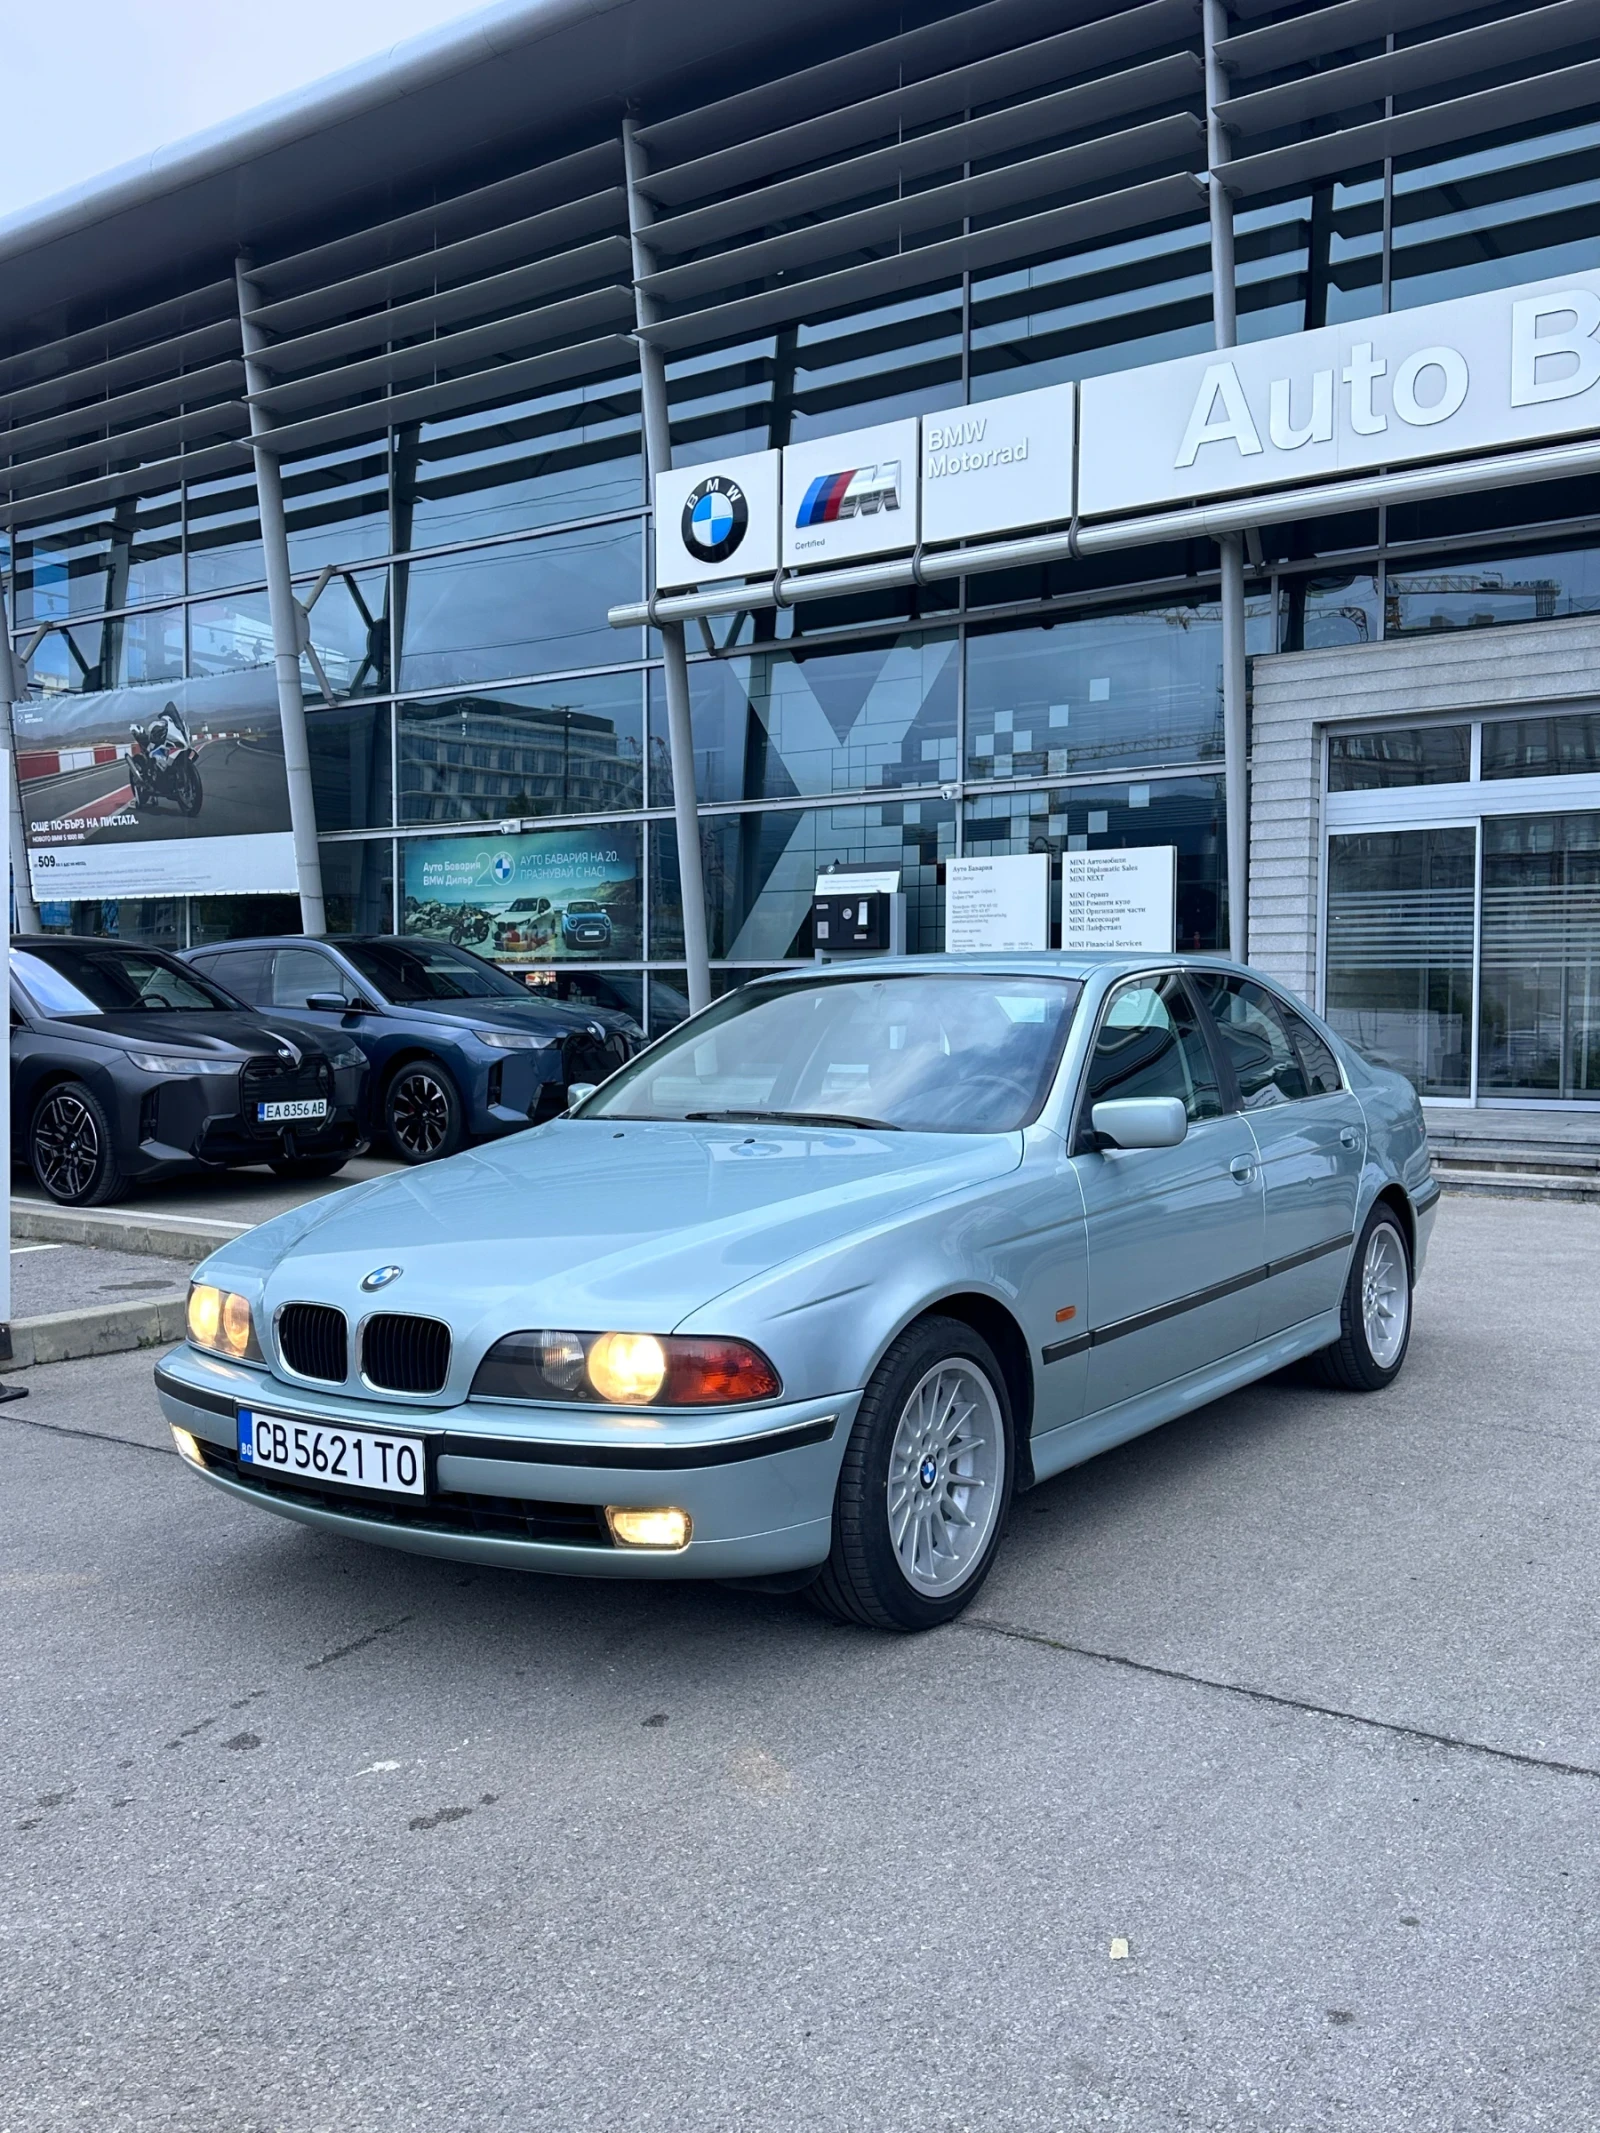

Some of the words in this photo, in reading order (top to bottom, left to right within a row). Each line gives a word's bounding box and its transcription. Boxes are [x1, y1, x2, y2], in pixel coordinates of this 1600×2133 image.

[1174, 342, 1469, 469] Auto
[929, 418, 987, 452] BMW
[928, 436, 1028, 479] Motorrad
[686, 478, 742, 510] BMW
[795, 538, 825, 550] Certified
[31, 820, 50, 832] ОЩЕ
[51, 819, 85, 830] ПО-БЪРЗ
[86, 817, 99, 828] НА
[100, 814, 139, 827] ПИСТАТА.
[38, 855, 56, 868] 509
[520, 853, 543, 866] АУТО
[545, 852, 588, 865] БАВАРИЯ
[590, 852, 604, 863] НА
[605, 850, 620, 862] 20.
[1087, 857, 1126, 865] Автомобили
[423, 862, 443, 874] Ауто
[445, 860, 481, 873] Бавария
[520, 866, 574, 880] ПРАЗНУВАЙ
[576, 867, 583, 878] С
[584, 866, 606, 878] НАС!
[1086, 865, 1120, 874] Diplomatic
[1121, 864, 1138, 872] Sales
[423, 875, 444, 886] BMW
[445, 875, 473, 887] Дилър
[1086, 874, 1104, 882] NEXT
[1086, 916, 1120, 924] Аксесоари
[1085, 940, 1114, 948] Financial
[1116, 939, 1142, 947] Services
[266, 1105, 281, 1118] EA
[283, 1102, 310, 1117] 8356
[311, 1101, 325, 1115] AB
[294, 1427, 365, 1479] 5621
